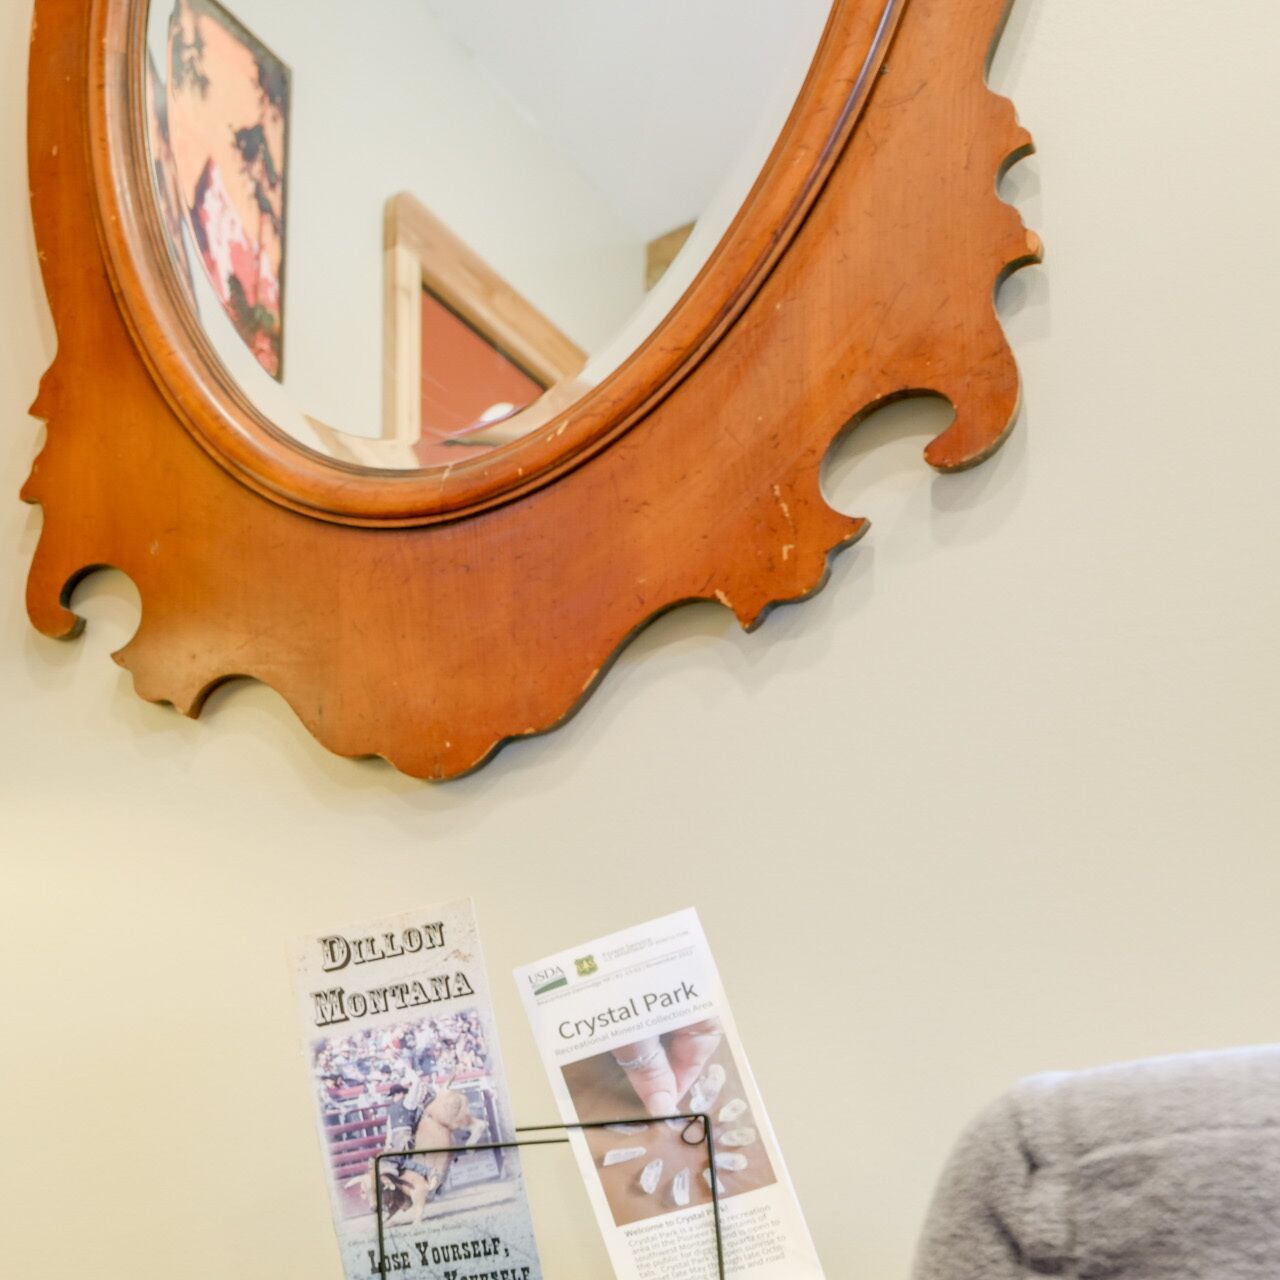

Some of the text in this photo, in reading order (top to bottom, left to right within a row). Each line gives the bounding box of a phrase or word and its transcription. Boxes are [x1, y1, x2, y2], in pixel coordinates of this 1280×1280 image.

[528, 965, 565, 984] USDA
[559, 998, 639, 1039] Crystal
[642, 981, 698, 1012] Park
[415, 1237, 509, 1267] YOURSELF,
